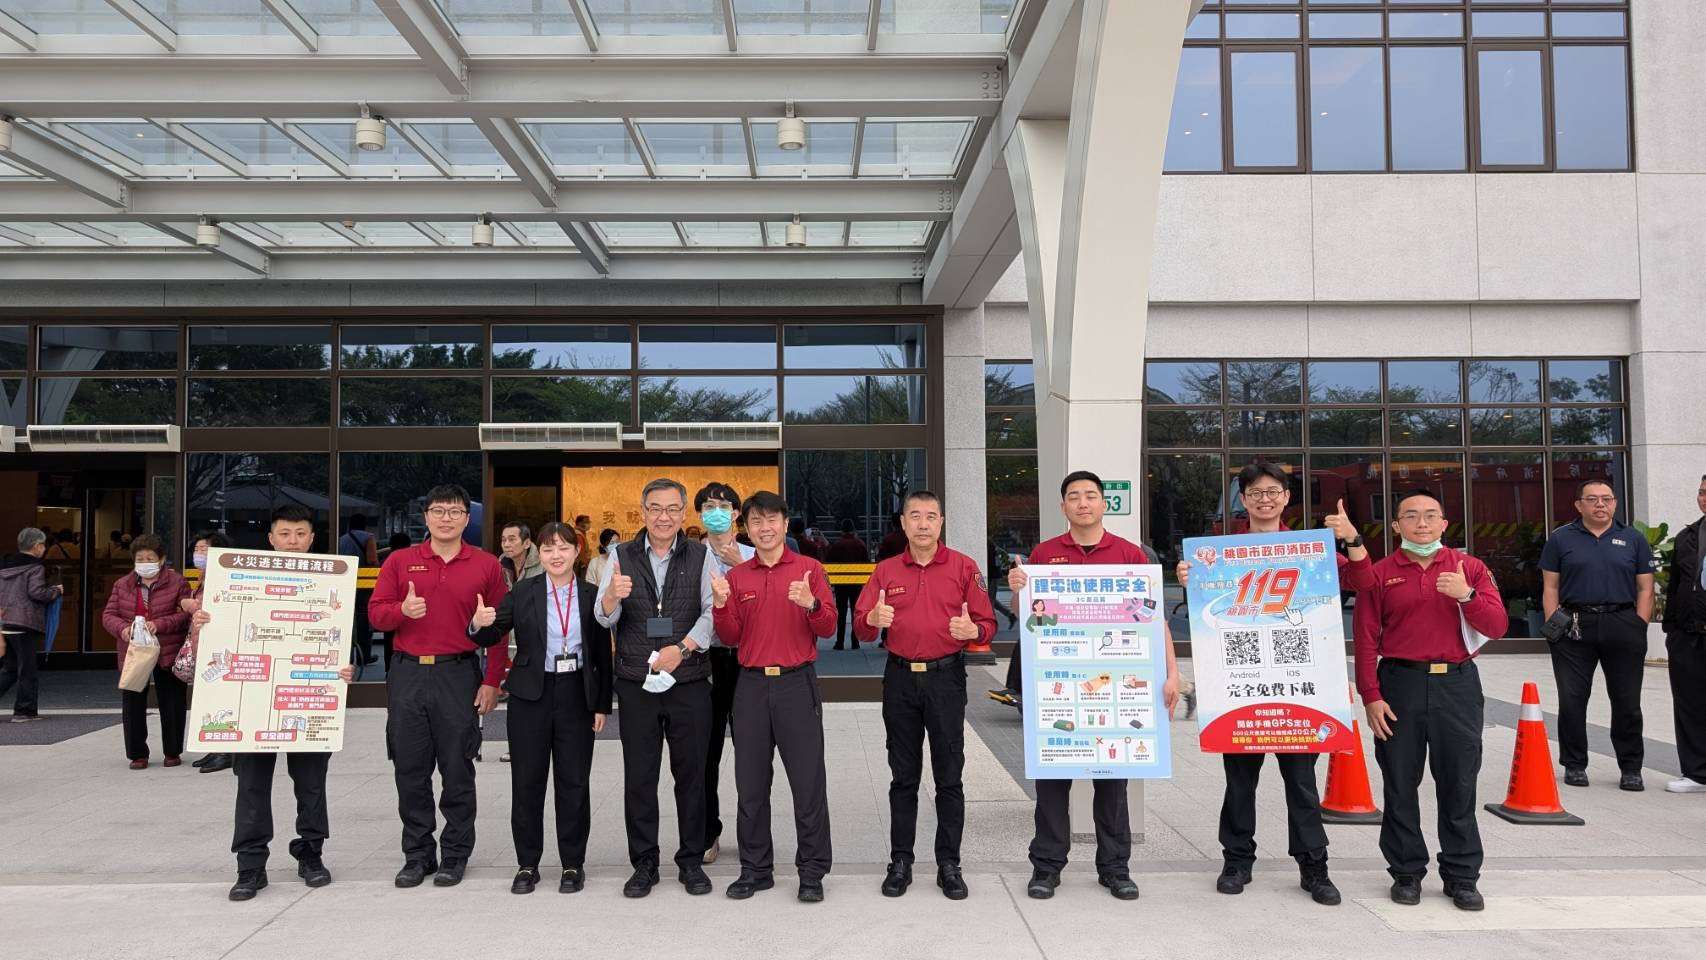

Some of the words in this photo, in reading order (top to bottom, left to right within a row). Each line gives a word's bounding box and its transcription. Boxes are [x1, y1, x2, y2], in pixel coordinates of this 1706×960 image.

[1224, 542, 1325, 559] 桃園市政府消防局
[233, 555, 334, 572] 火災逃生避難流程
[1034, 578, 1147, 593] 鋰電池使用安全
[1233, 567, 1301, 615] 119
[1229, 670, 1260, 679] Android
[1226, 682, 1316, 698] 完全免費下載
